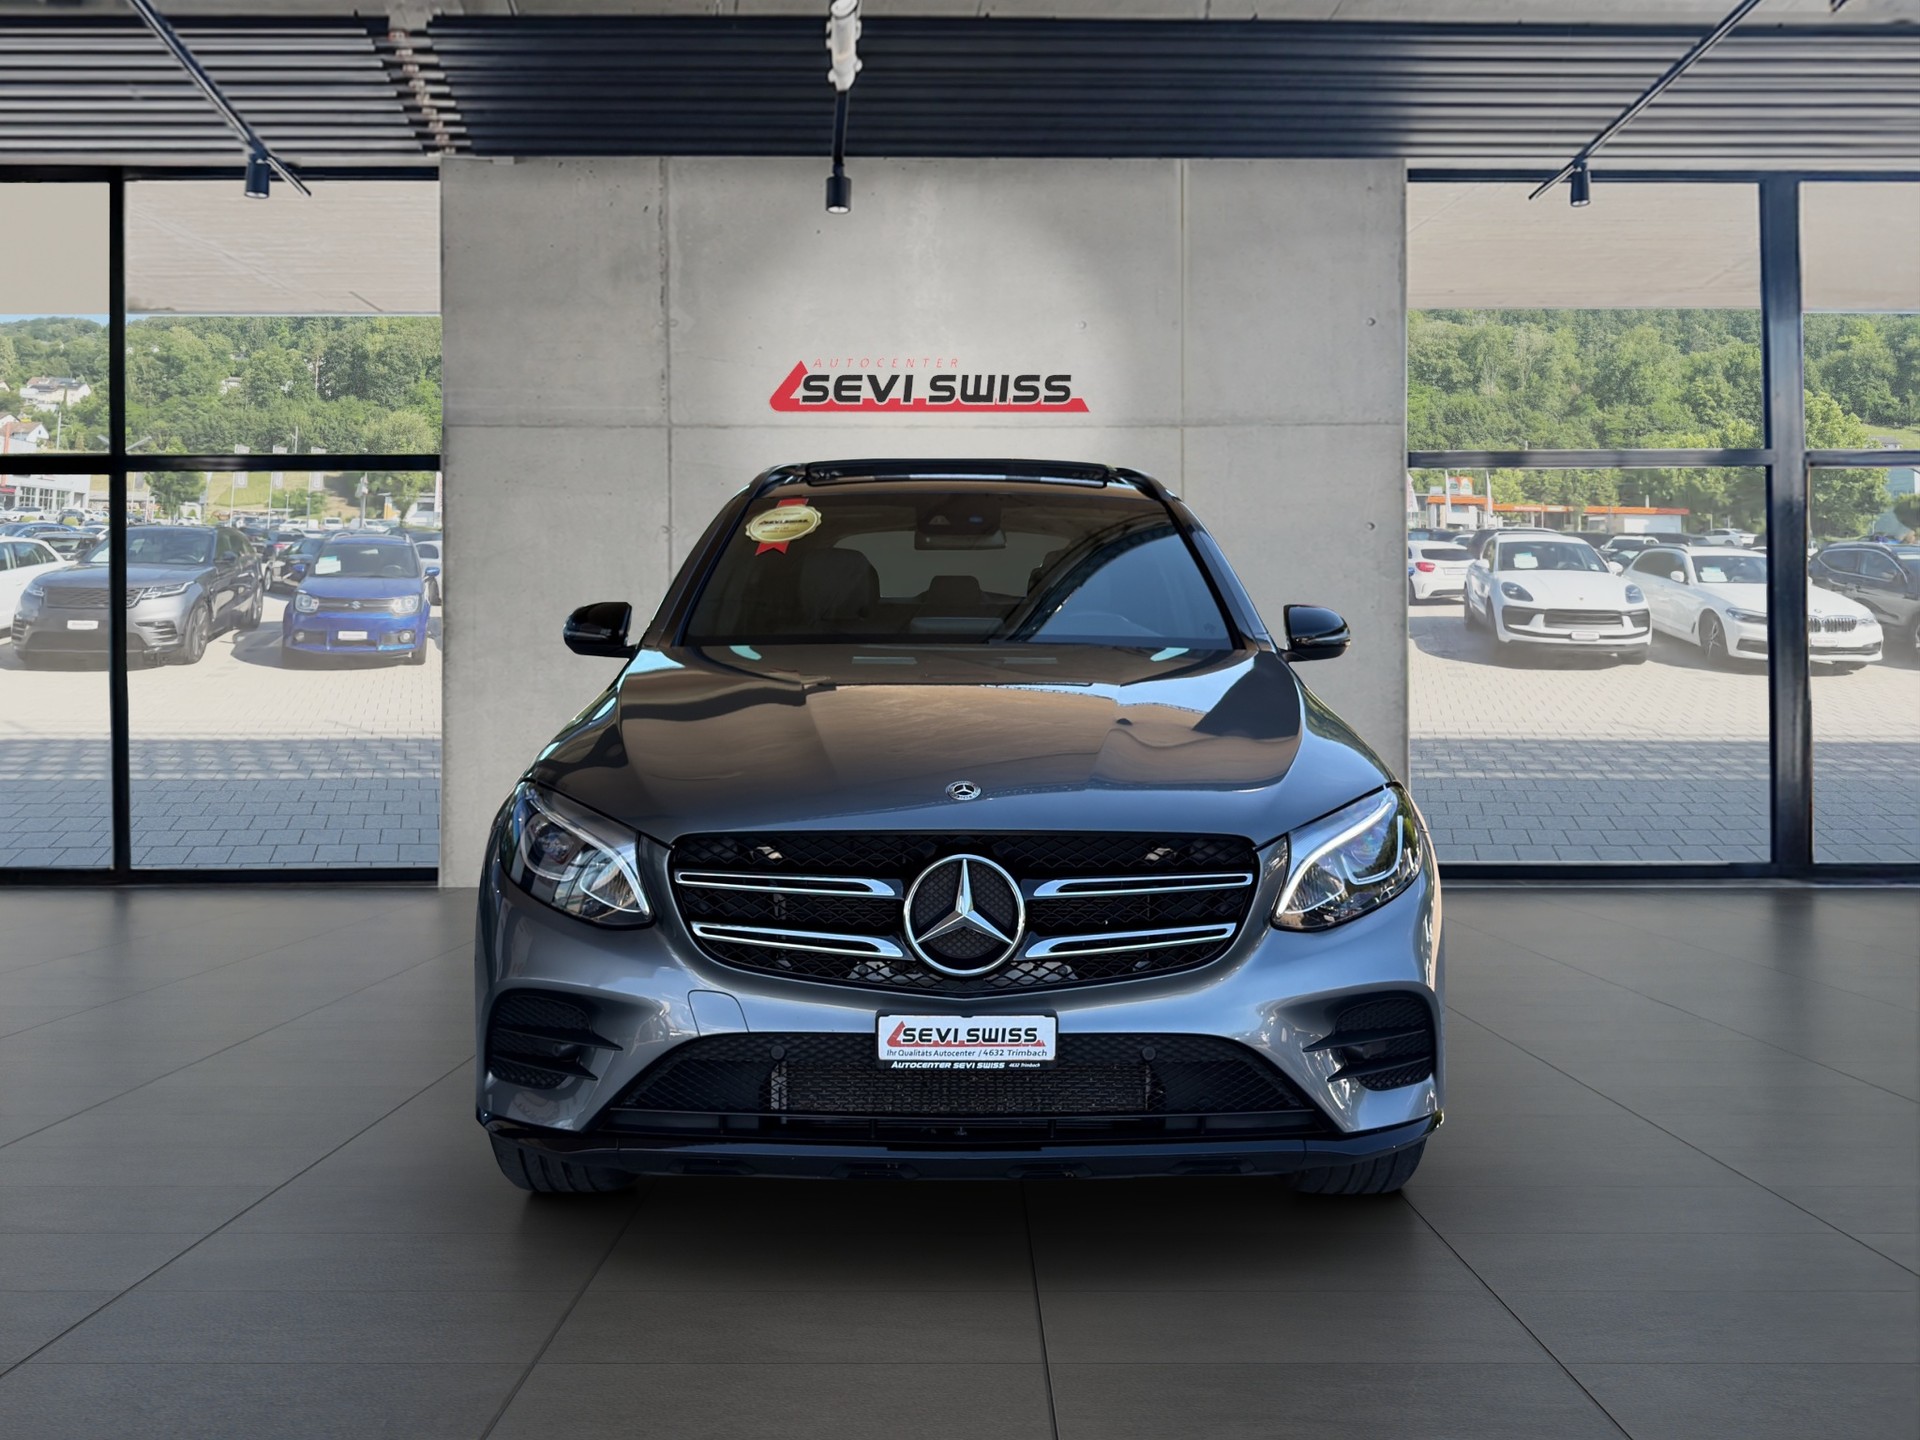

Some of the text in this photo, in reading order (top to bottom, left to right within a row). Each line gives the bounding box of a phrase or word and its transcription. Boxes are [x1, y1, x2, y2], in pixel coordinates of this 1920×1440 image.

[812, 358, 960, 369] AUTOCENTER
[801, 374, 1072, 404] SEVI SWISS
[902, 1027, 1038, 1043] SEVI SWISS
[886, 1049, 897, 1057] Ihr
[1007, 1049, 1048, 1057] Trimbach
[891, 1060, 952, 1069] AUTOCENTER
[953, 1061, 975, 1069] SEVI
[976, 1061, 1006, 1069] SWISS
